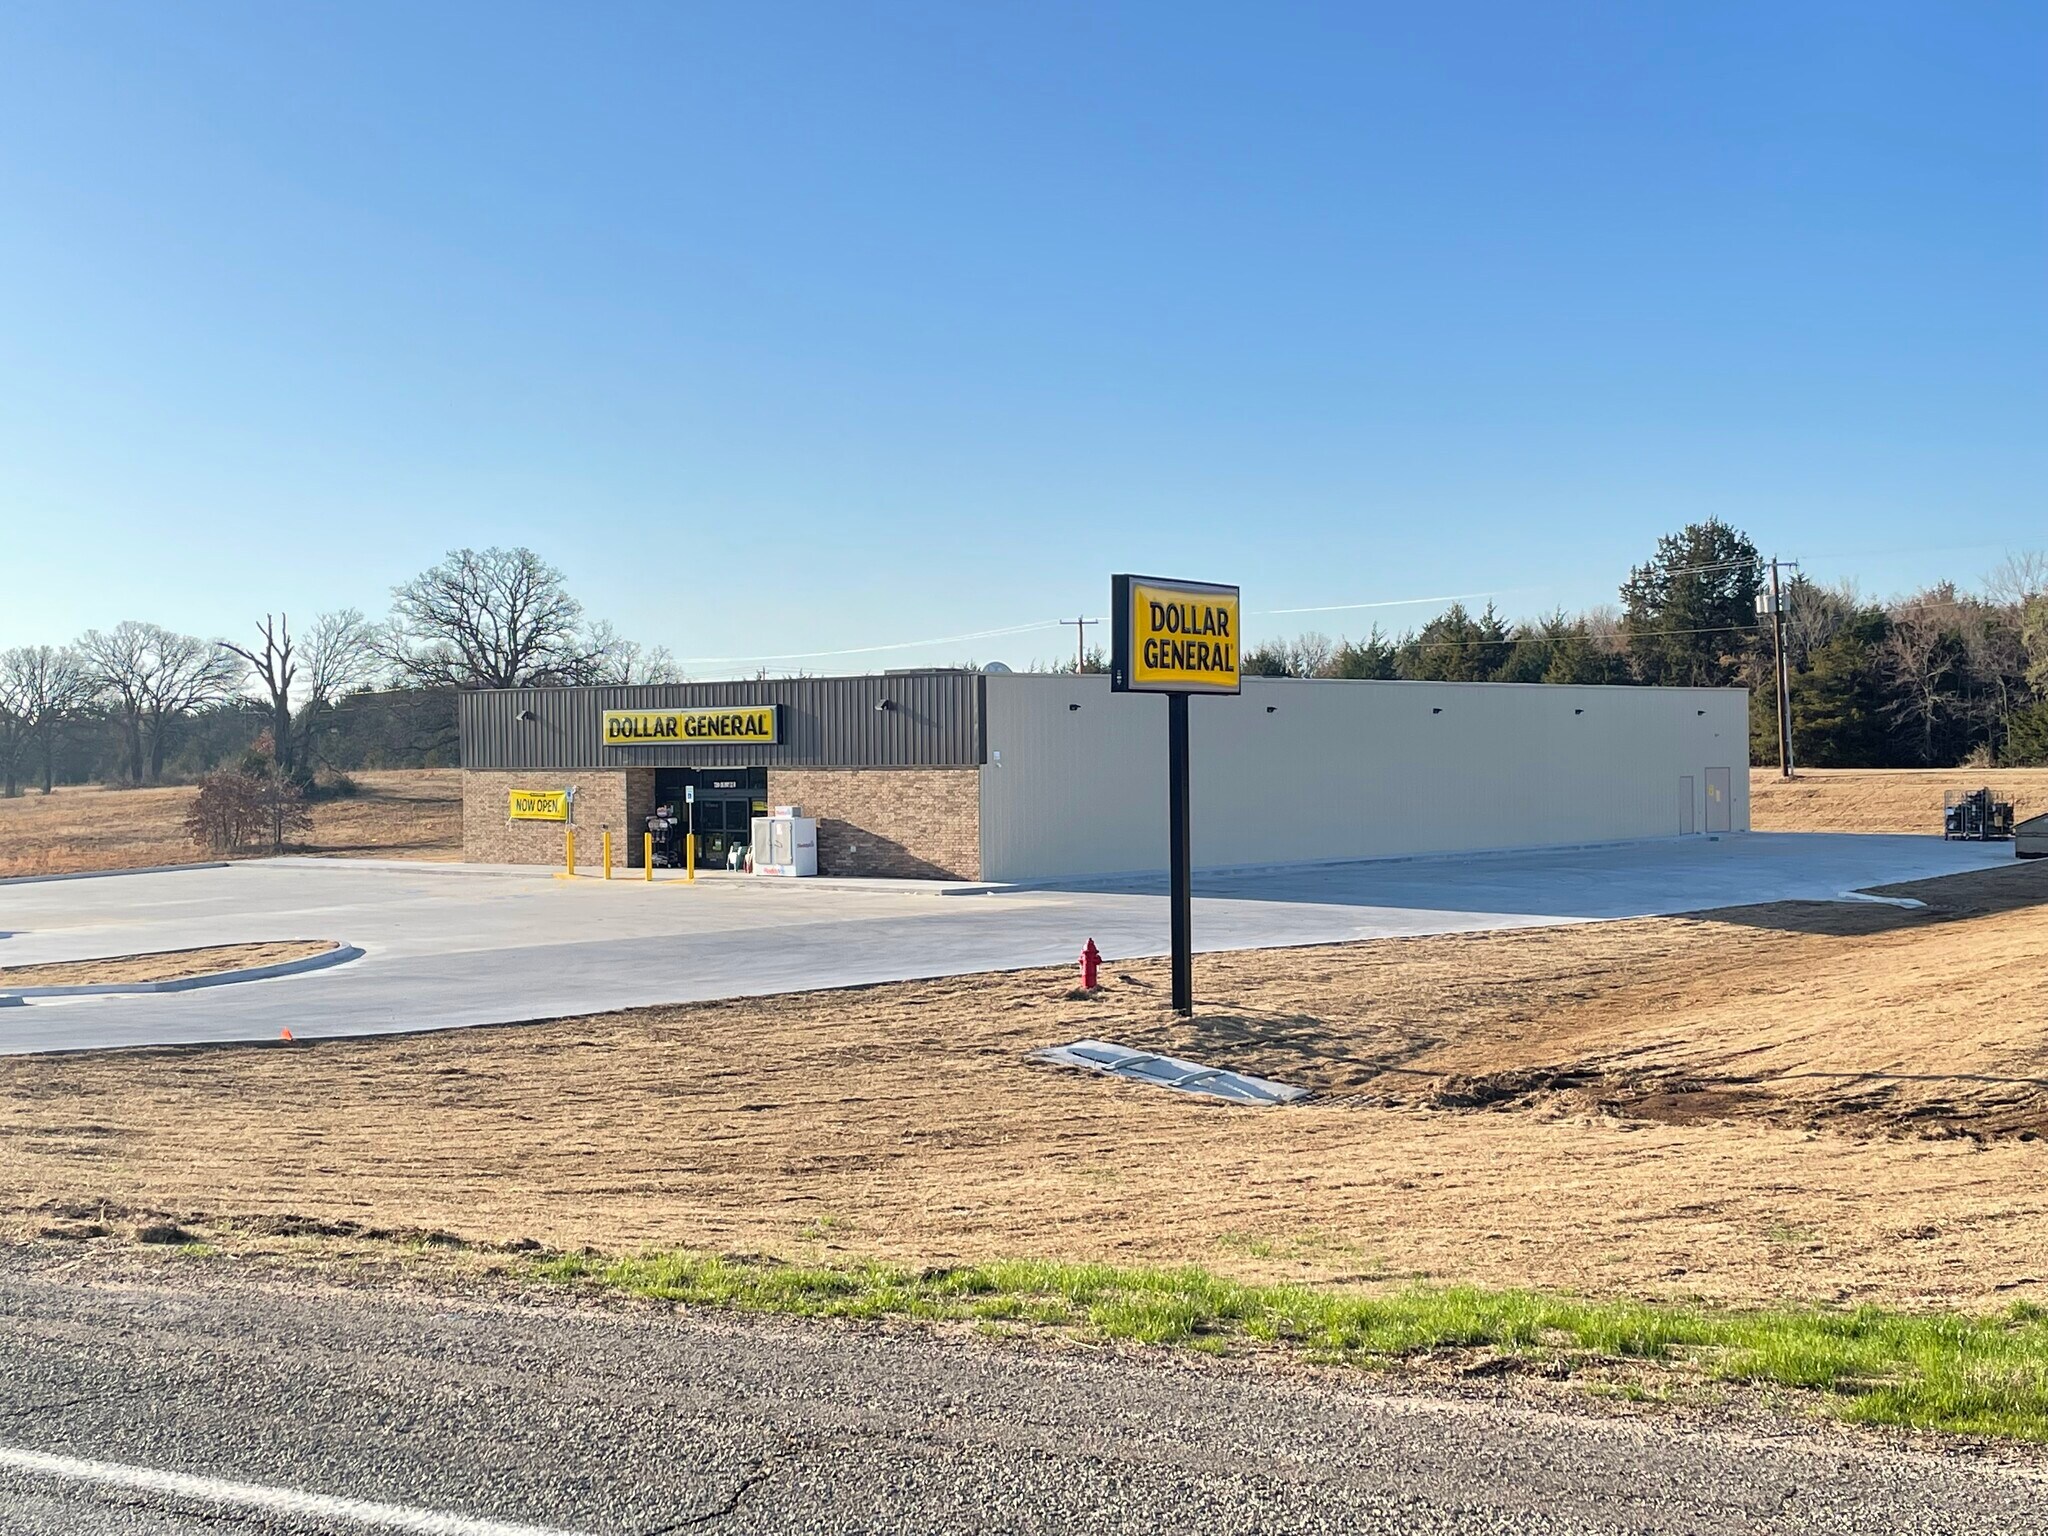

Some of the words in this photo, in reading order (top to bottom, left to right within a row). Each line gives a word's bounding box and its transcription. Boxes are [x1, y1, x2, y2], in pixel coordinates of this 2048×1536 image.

[1149, 601, 1230, 637] DOLLAR
[1143, 637, 1235, 673] GENERAL
[608, 716, 679, 739] DOLLAR
[683, 713, 769, 738] GENERAL
[516, 798, 535, 812] NOW
